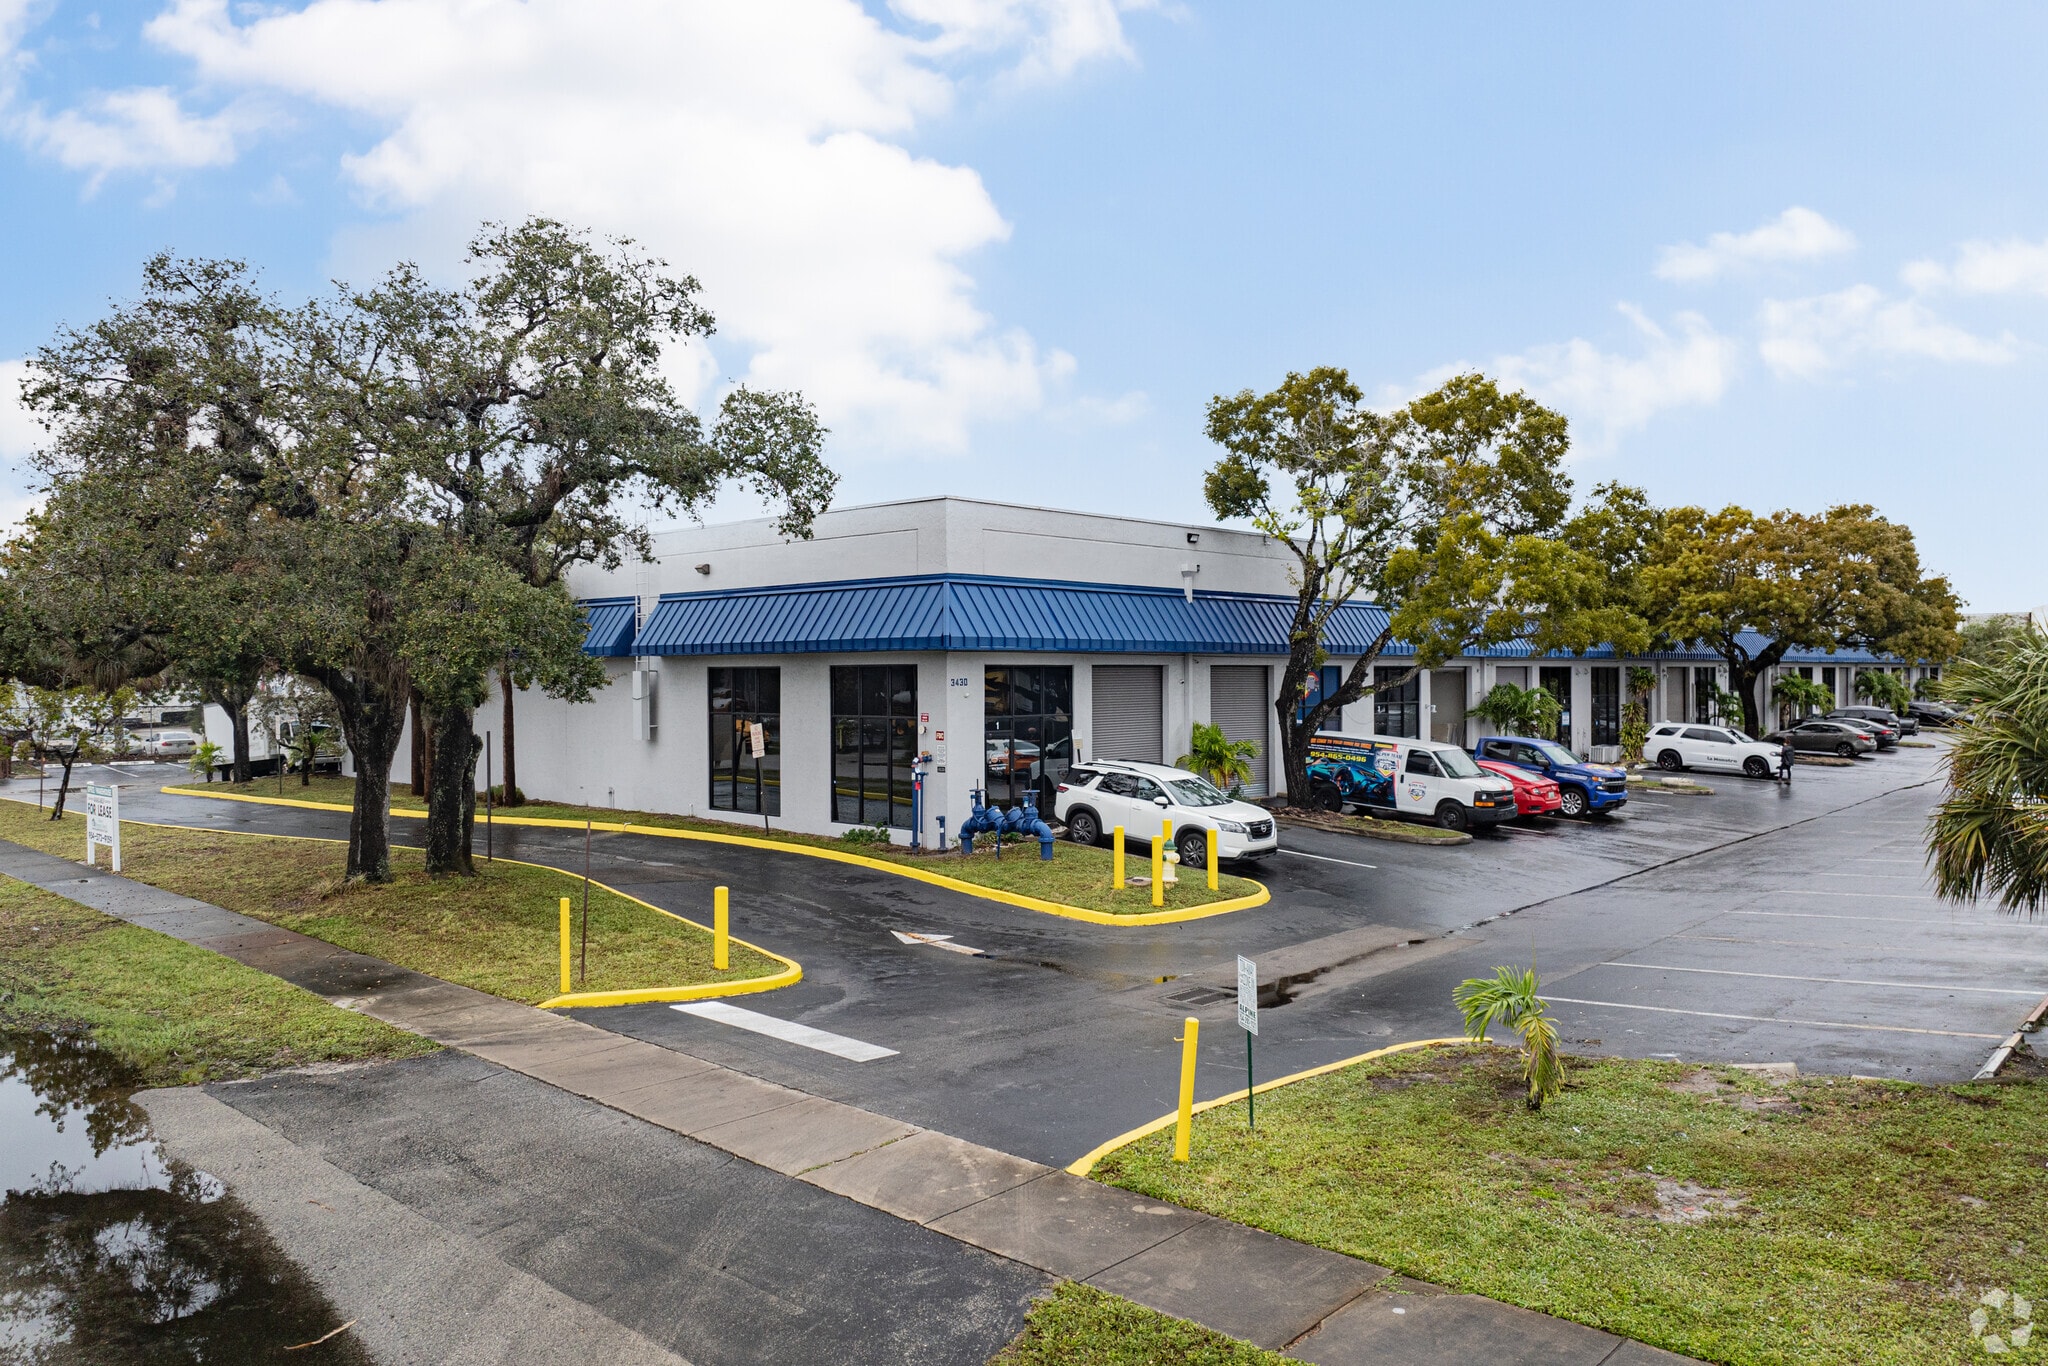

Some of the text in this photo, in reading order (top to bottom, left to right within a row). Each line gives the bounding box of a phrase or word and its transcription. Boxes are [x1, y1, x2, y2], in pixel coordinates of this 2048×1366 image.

[950, 678, 968, 686] 3430
[996, 721, 1000, 730] 1
[1310, 751, 1366, 762] 954-865-0496
[88, 803, 112, 819] FOR LEASE
[1239, 1004, 1256, 1018] ALPINE
